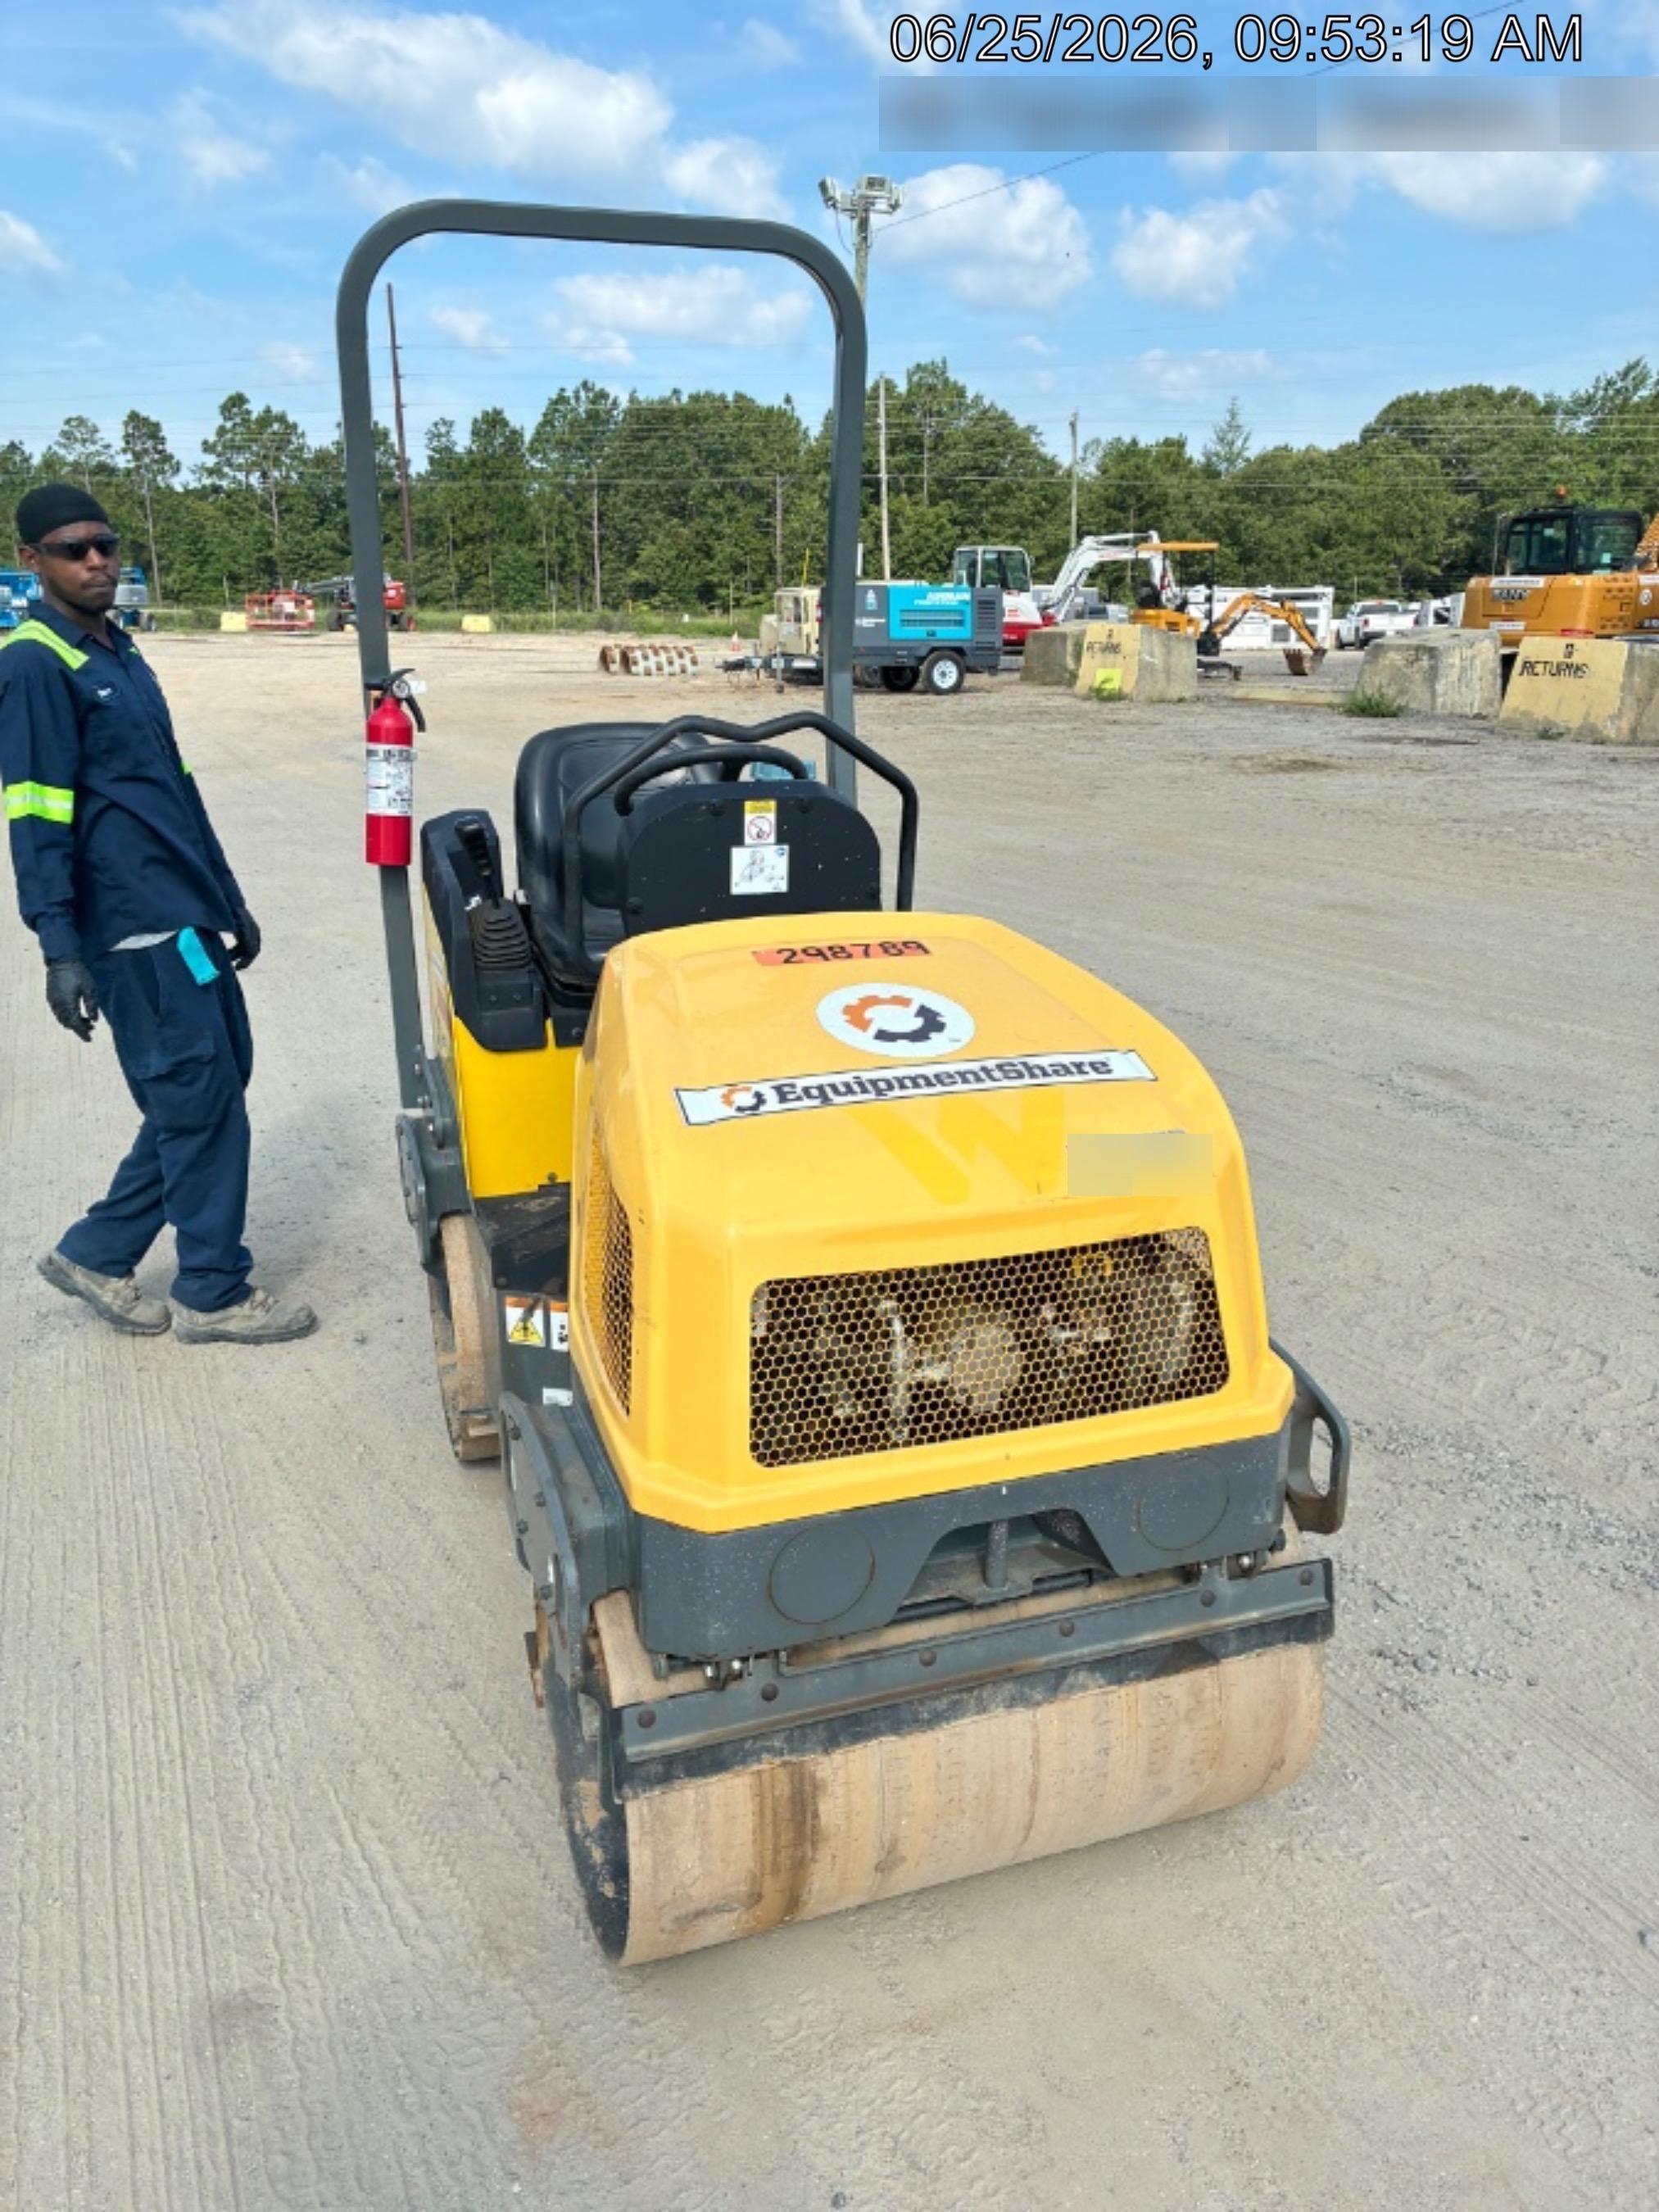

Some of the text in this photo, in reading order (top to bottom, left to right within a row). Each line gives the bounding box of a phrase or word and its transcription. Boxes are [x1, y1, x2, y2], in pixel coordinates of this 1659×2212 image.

[1518, 660, 1590, 679] RETURNS
[775, 941, 931, 965] 298789
[771, 1058, 1115, 1107] EquipmentShare
